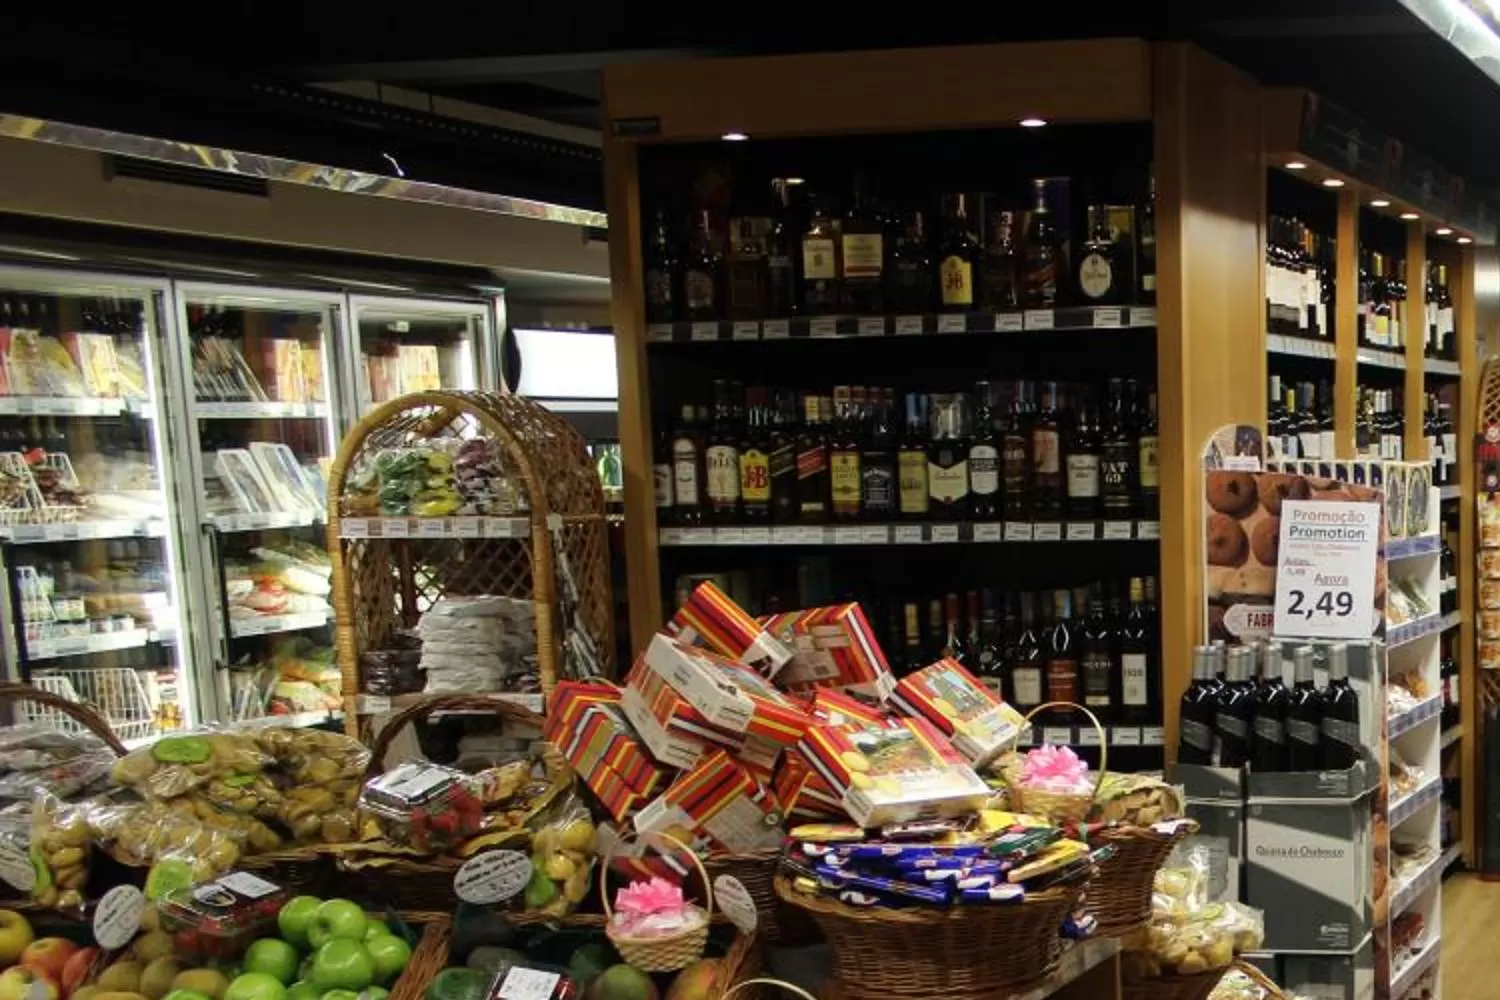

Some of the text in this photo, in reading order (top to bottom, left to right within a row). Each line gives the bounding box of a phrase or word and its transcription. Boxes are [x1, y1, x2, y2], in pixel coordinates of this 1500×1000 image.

[744, 465, 768, 488] J&B
[1293, 508, 1366, 525] Promoção
[1289, 525, 1366, 540] Promotion
[1287, 589, 1353, 620] 2,49
